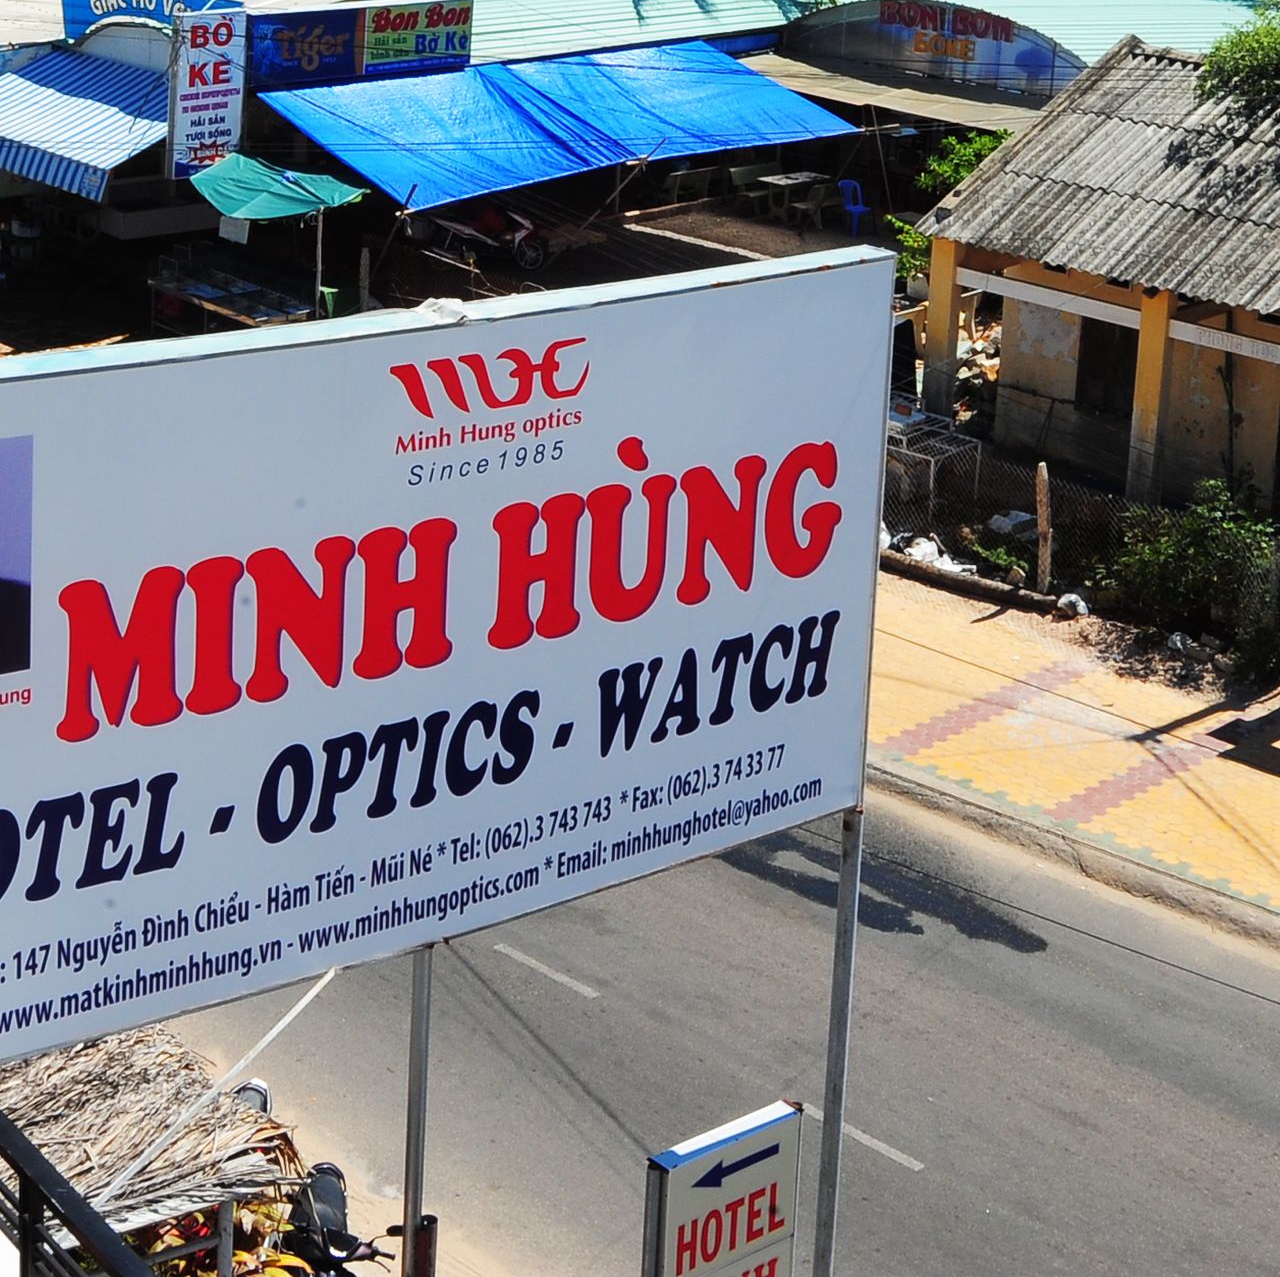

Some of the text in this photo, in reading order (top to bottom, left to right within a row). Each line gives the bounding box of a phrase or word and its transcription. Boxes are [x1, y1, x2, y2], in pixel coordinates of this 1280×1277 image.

[276, 23, 350, 72] Tiger
[372, 3, 471, 33] Bon Bon
[395, 408, 582, 455] Minh Hung optics
[407, 440, 564, 486] Since 1985
[56, 436, 842, 742] MINH HÙNG
[256, 689, 540, 844] OPTICS
[597, 610, 840, 758] WATCH
[13, 943, 51, 979] 147
[57, 921, 136, 974] Nguyễn
[142, 909, 189, 947] Đình
[194, 891, 250, 933] Chiểu
[267, 883, 310, 916] Hàm
[315, 865, 354, 904] Tiến
[370, 851, 405, 888] Mũi
[410, 845, 433, 876] Né
[450, 832, 481, 865] Tel:
[485, 816, 544, 860] (062).3
[548, 805, 578, 838] 743
[583, 795, 612, 828] 743
[632, 784, 663, 813] Fax:
[667, 763, 720, 806] (062).3
[725, 757, 743, 785] 74
[745, 749, 764, 779] 33
[767, 742, 786, 772] 77
[298, 864, 540, 954] www.minhhungoptics.com
[557, 844, 608, 879] Email:
[611, 777, 822, 862] minhhunghotel@yahoo.com
[675, 1181, 785, 1277] HOTEL
